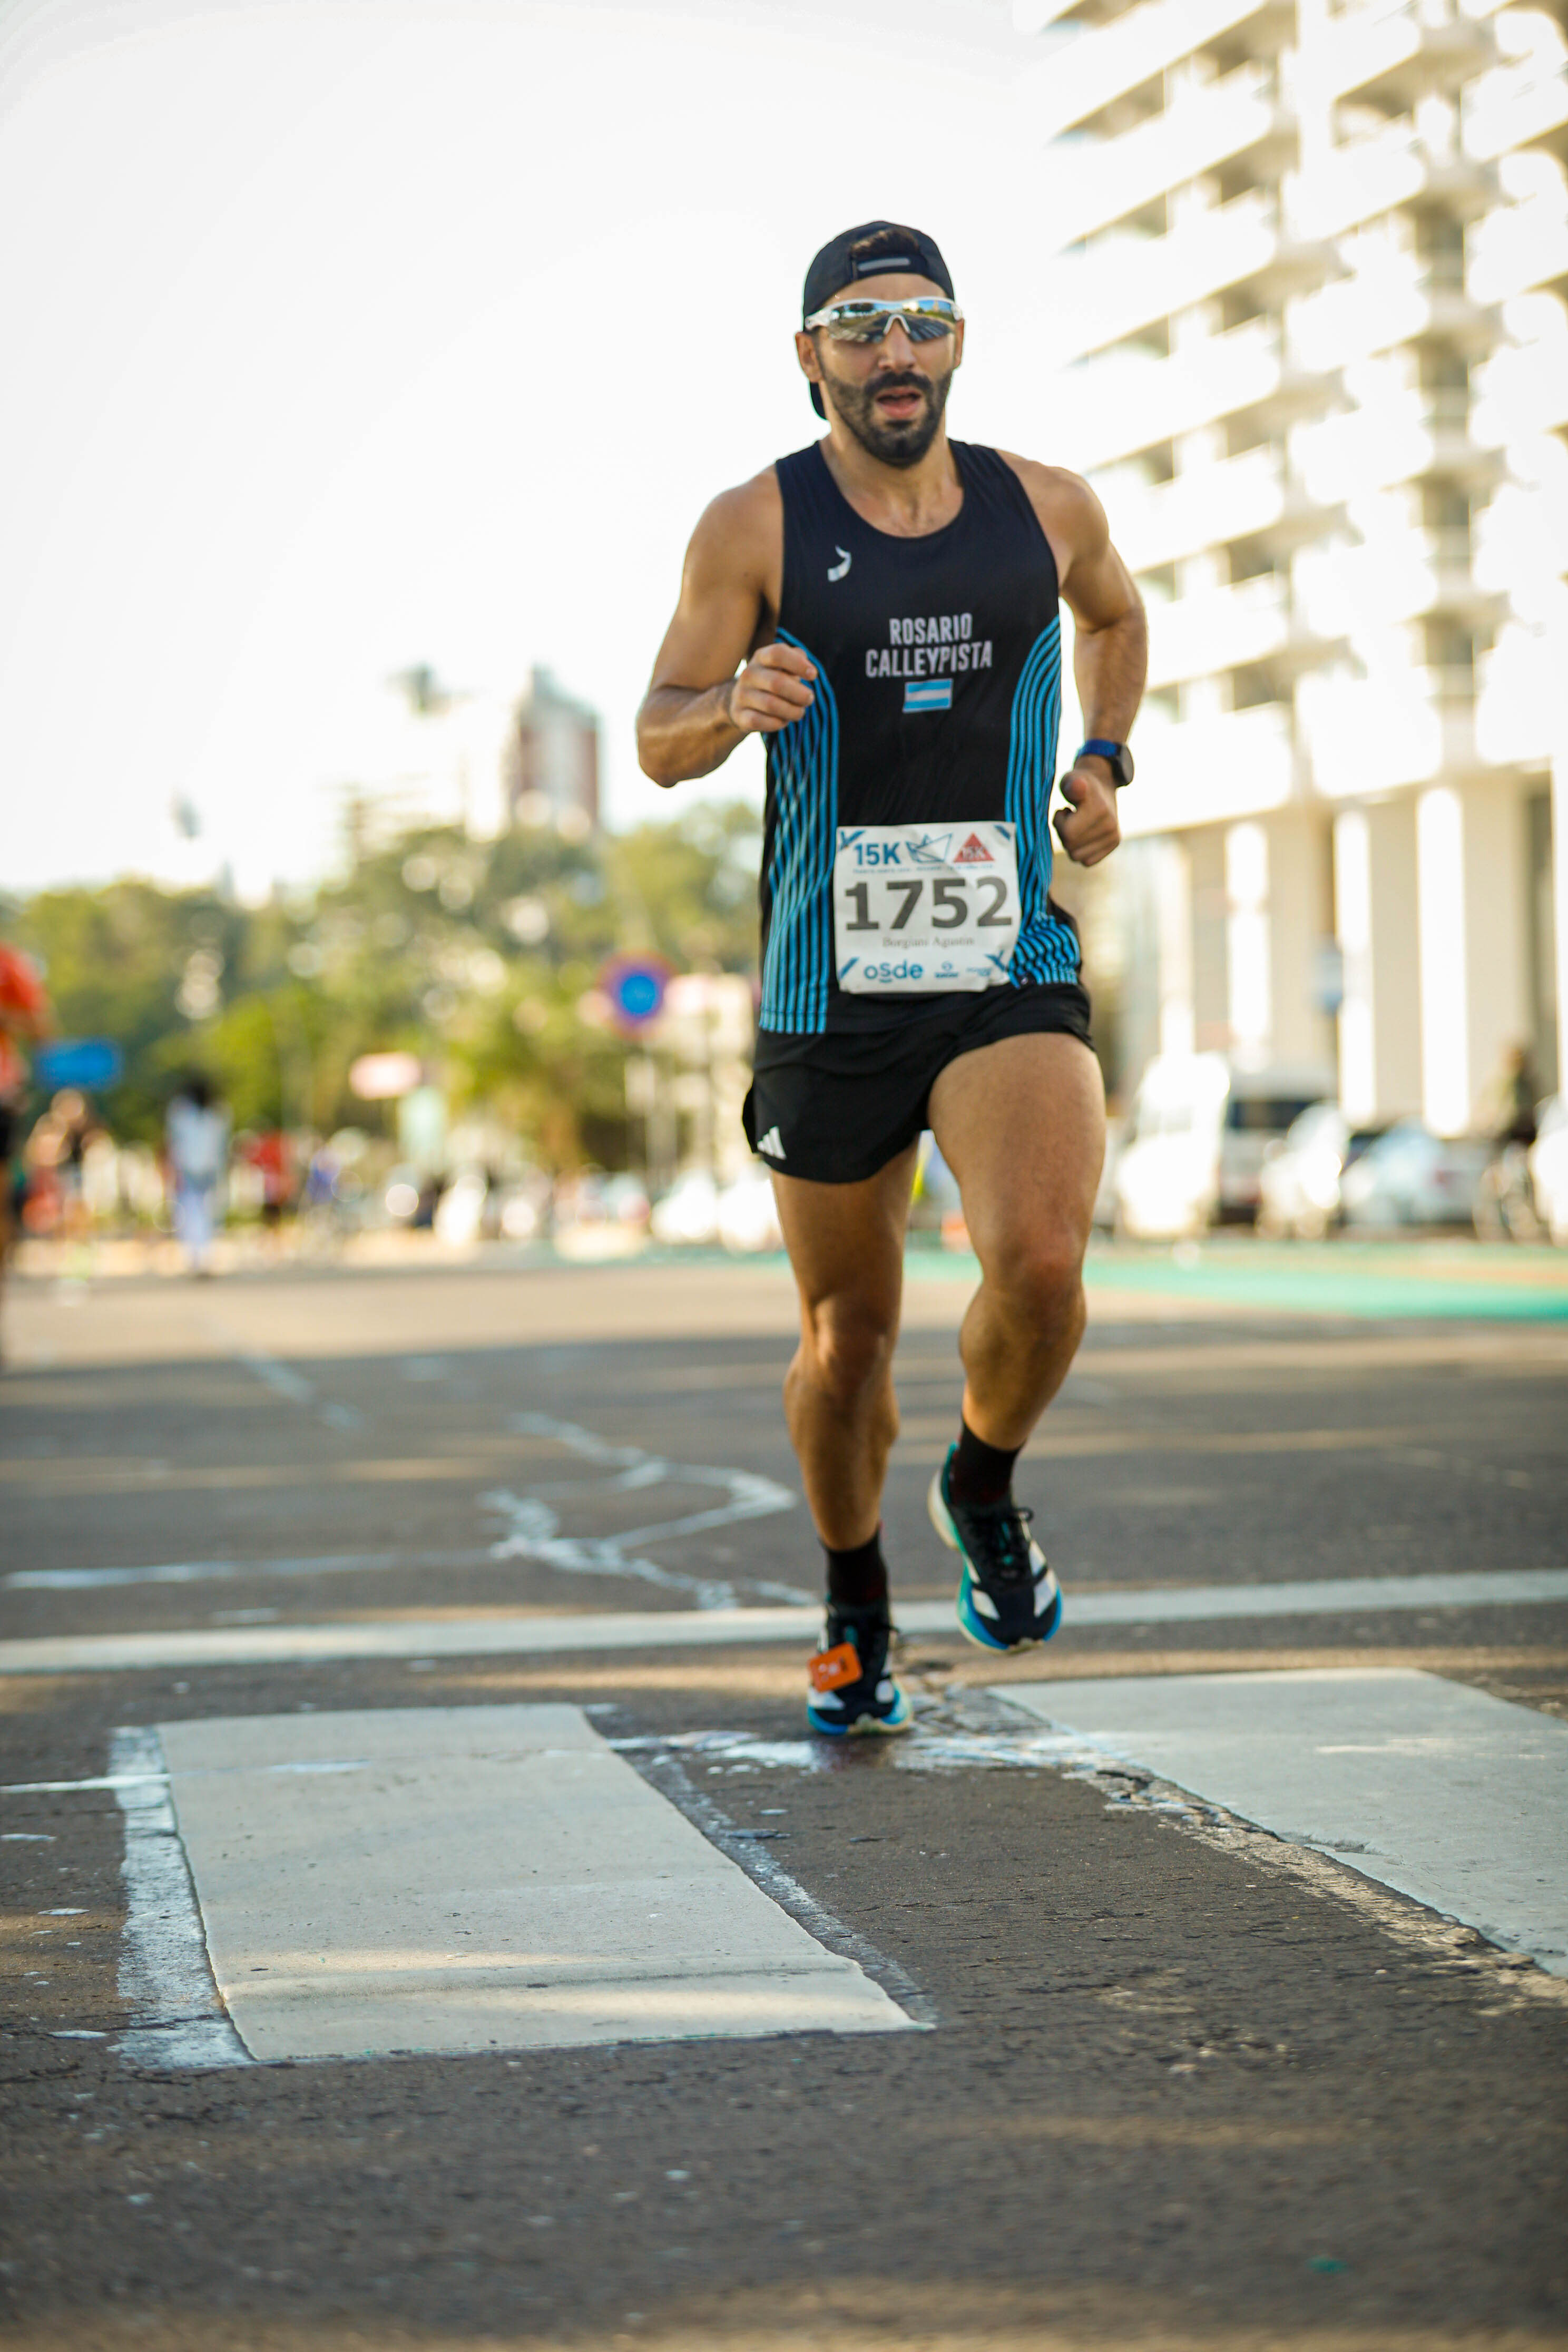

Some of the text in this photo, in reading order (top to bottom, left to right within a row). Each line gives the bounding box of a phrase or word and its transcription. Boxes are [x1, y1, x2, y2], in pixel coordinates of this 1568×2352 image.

[889, 613, 973, 645] ROSARIO
[865, 641, 993, 678] CALLEYPISTA
[854, 842, 900, 865] 15K
[845, 877, 1013, 930] 1752
[864, 961, 923, 980] osde
